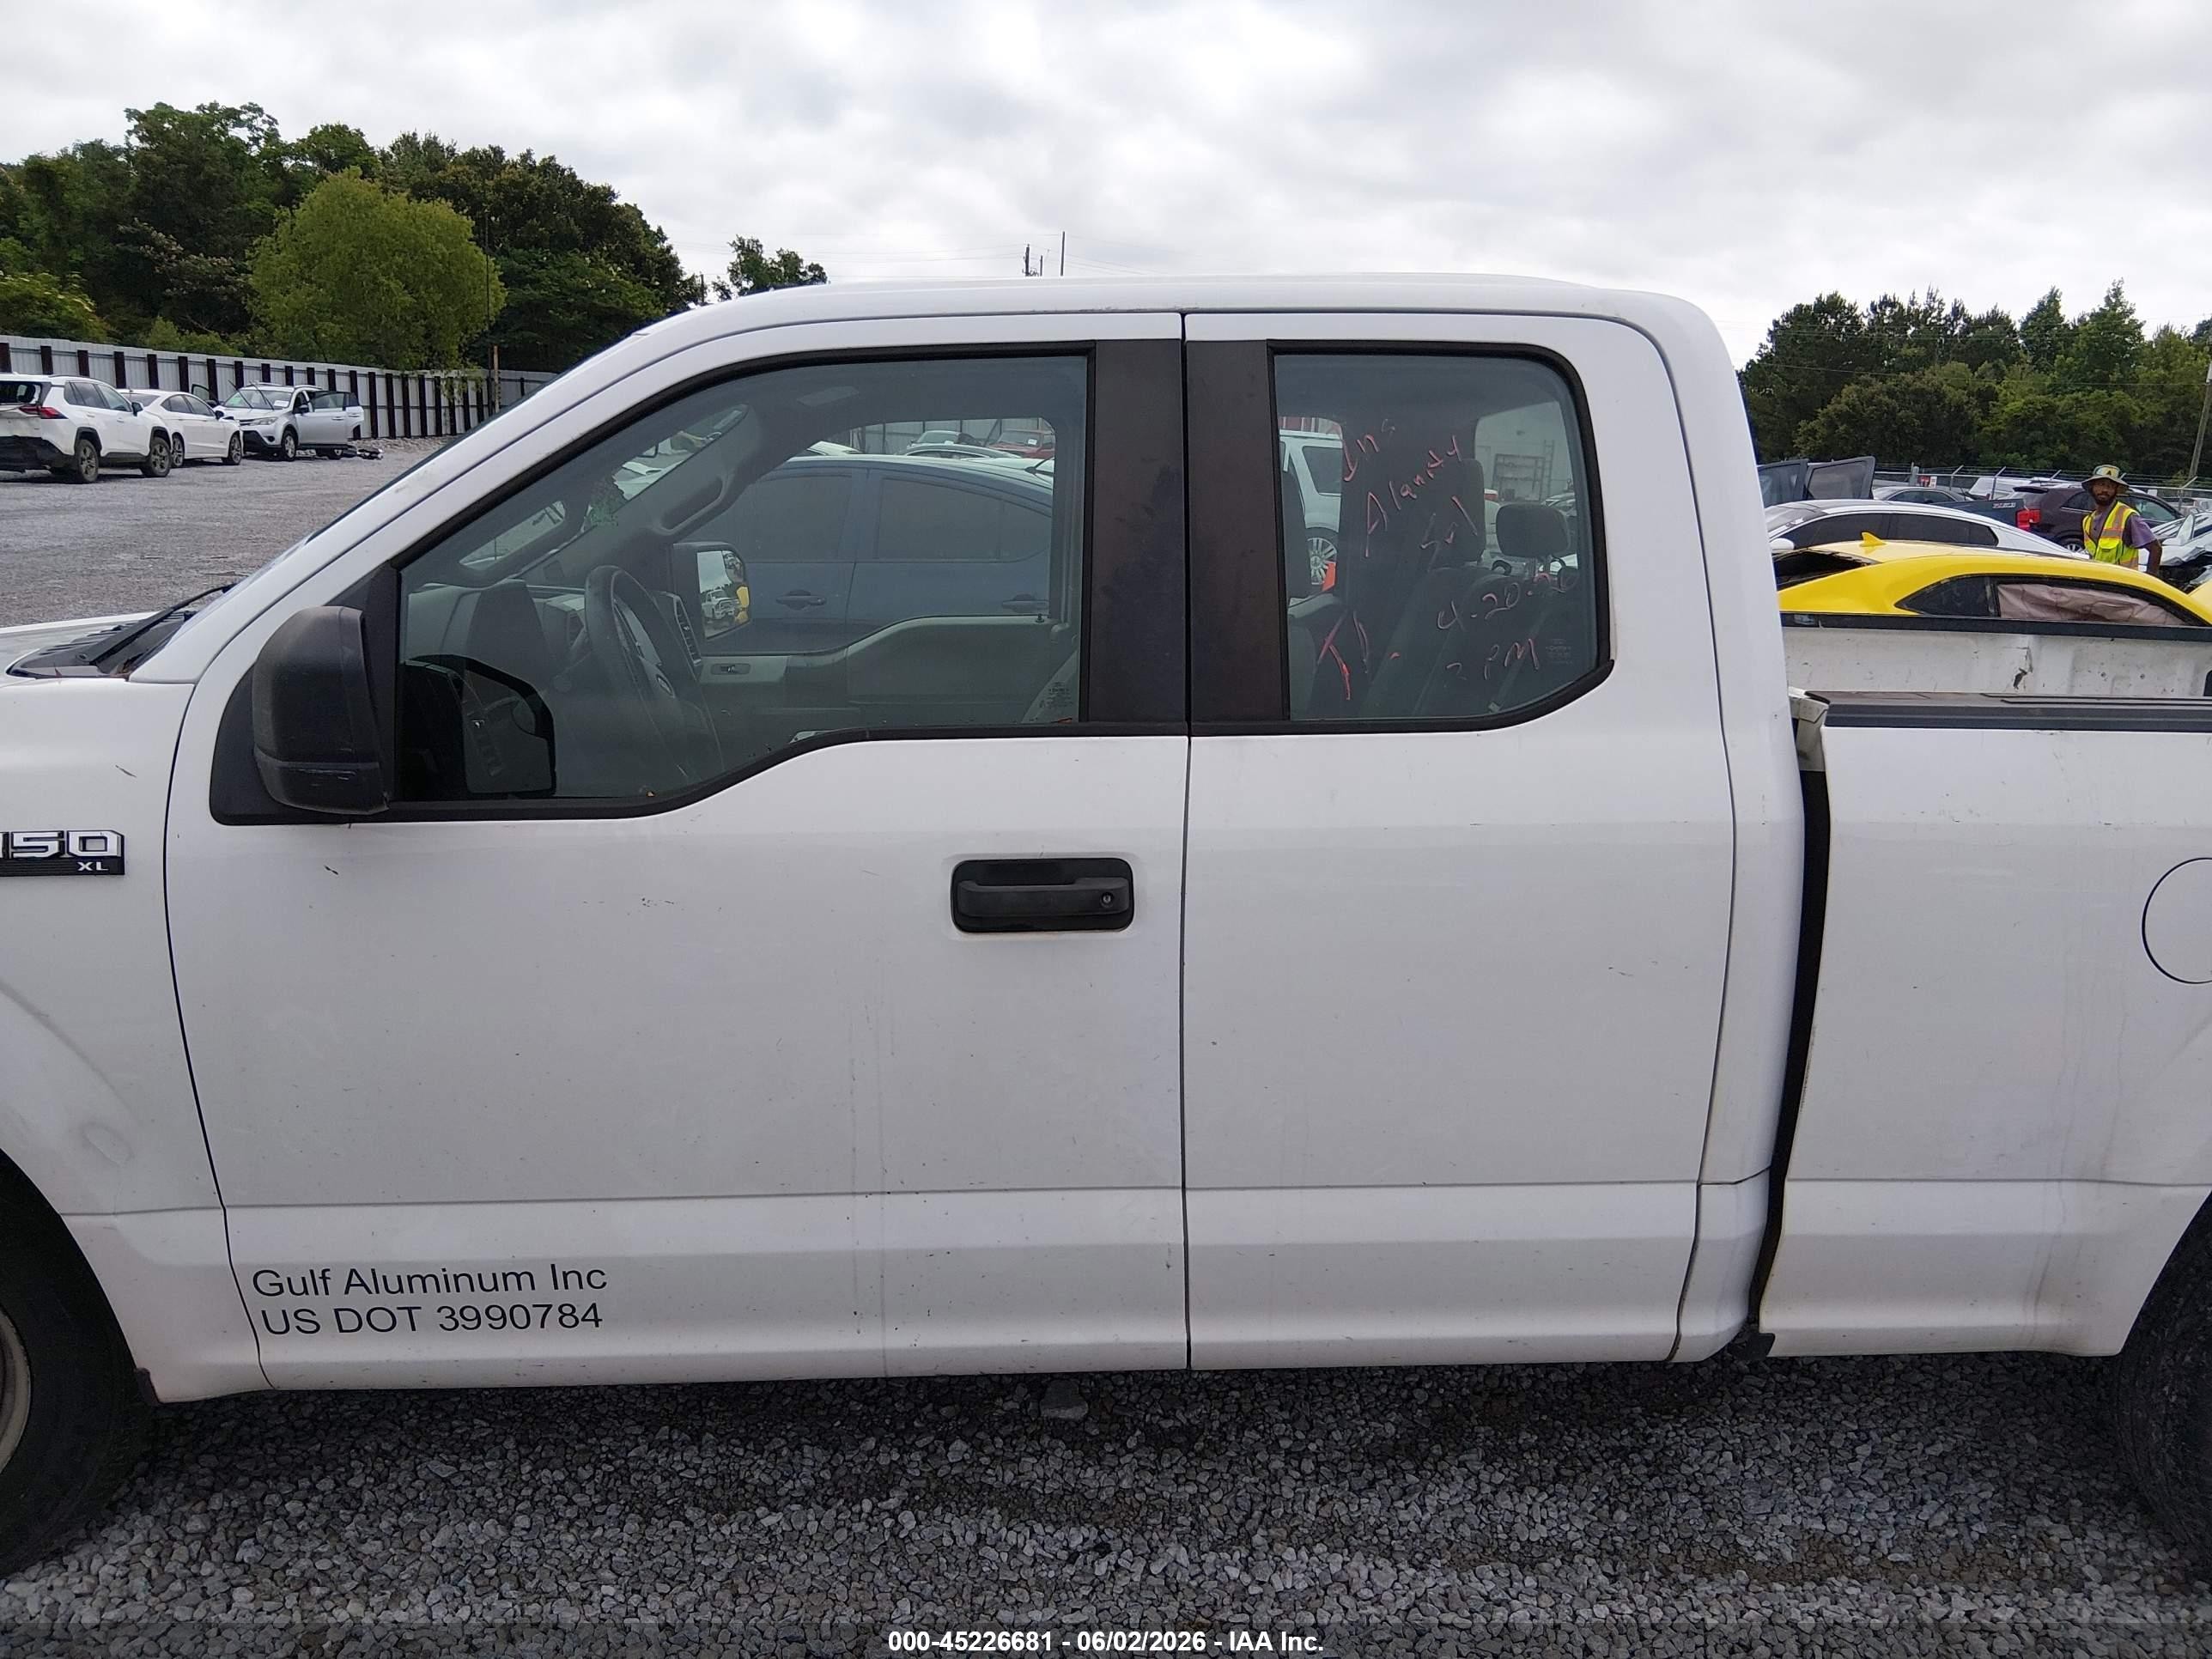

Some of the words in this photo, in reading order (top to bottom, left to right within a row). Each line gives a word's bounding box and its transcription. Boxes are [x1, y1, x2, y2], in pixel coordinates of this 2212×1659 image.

[77, 861, 109, 872] XL
[252, 1267, 331, 1297] Gulf
[343, 1267, 536, 1296] Aluminum
[550, 1263, 607, 1291] Inc
[260, 1308, 321, 1335] US
[333, 1306, 422, 1334] DOT
[436, 1302, 603, 1332] 3990784
